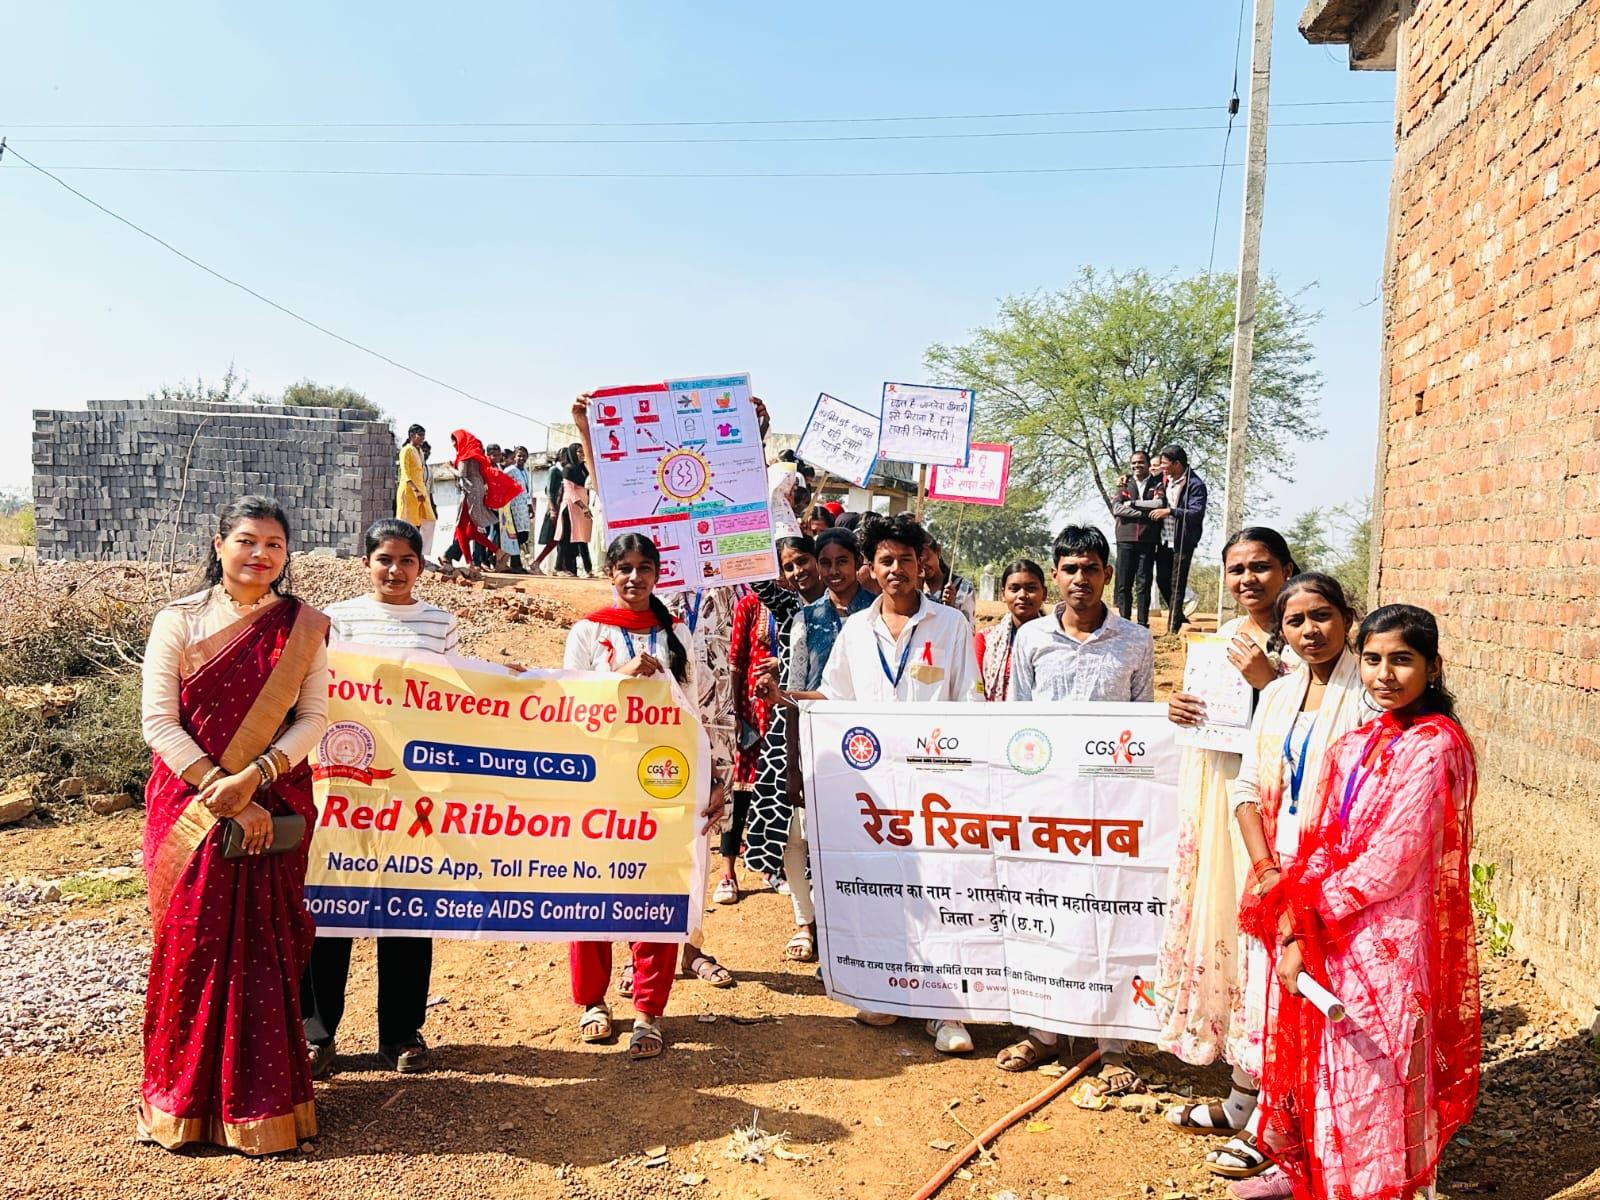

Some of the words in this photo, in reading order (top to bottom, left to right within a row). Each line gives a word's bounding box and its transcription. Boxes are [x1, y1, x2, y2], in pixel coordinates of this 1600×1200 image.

[402, 679, 510, 718] Naveen
[520, 695, 617, 732] College
[412, 746, 460, 766] Dist.
[479, 752, 526, 775] Durg
[533, 756, 587, 780] (C.G.)
[320, 795, 402, 831] Red
[440, 802, 571, 838] Ribbon
[581, 808, 658, 841] Club
[855, 792, 914, 847] रेड
[920, 792, 1022, 851] रिबन
[1028, 816, 1144, 858] क्लब
[327, 852, 378, 872] Naco
[383, 855, 433, 874] AIDS
[438, 857, 483, 880] App,
[490, 859, 522, 877] Toll
[528, 860, 567, 878] Free
[573, 861, 601, 879] No.
[608, 862, 647, 880] 1097
[303, 898, 370, 915] onsor
[387, 897, 428, 918] C.G.
[435, 898, 484, 918] Stete
[487, 900, 534, 919] AIDS
[540, 900, 606, 920] Control
[612, 901, 675, 925] Society
[835, 877, 903, 898] महाविद्यालय
[906, 884, 923, 899] का
[926, 885, 951, 900] नाम
[967, 885, 1021, 904] शासकीय
[1025, 888, 1059, 908] नवीन
[1062, 893, 1143, 916] महाविद्यालय
[1147, 896, 1168, 917] बो
[939, 907, 974, 926] जिला
[990, 909, 1008, 932] दुर्ग
[866, 960, 884, 970] राज्य
[885, 962, 902, 974] एड्स
[936, 964, 961, 975] समिति
[985, 968, 1001, 977] उच्च
[1024, 970, 1046, 985] विभाग
[1088, 983, 1113, 993] शासन
